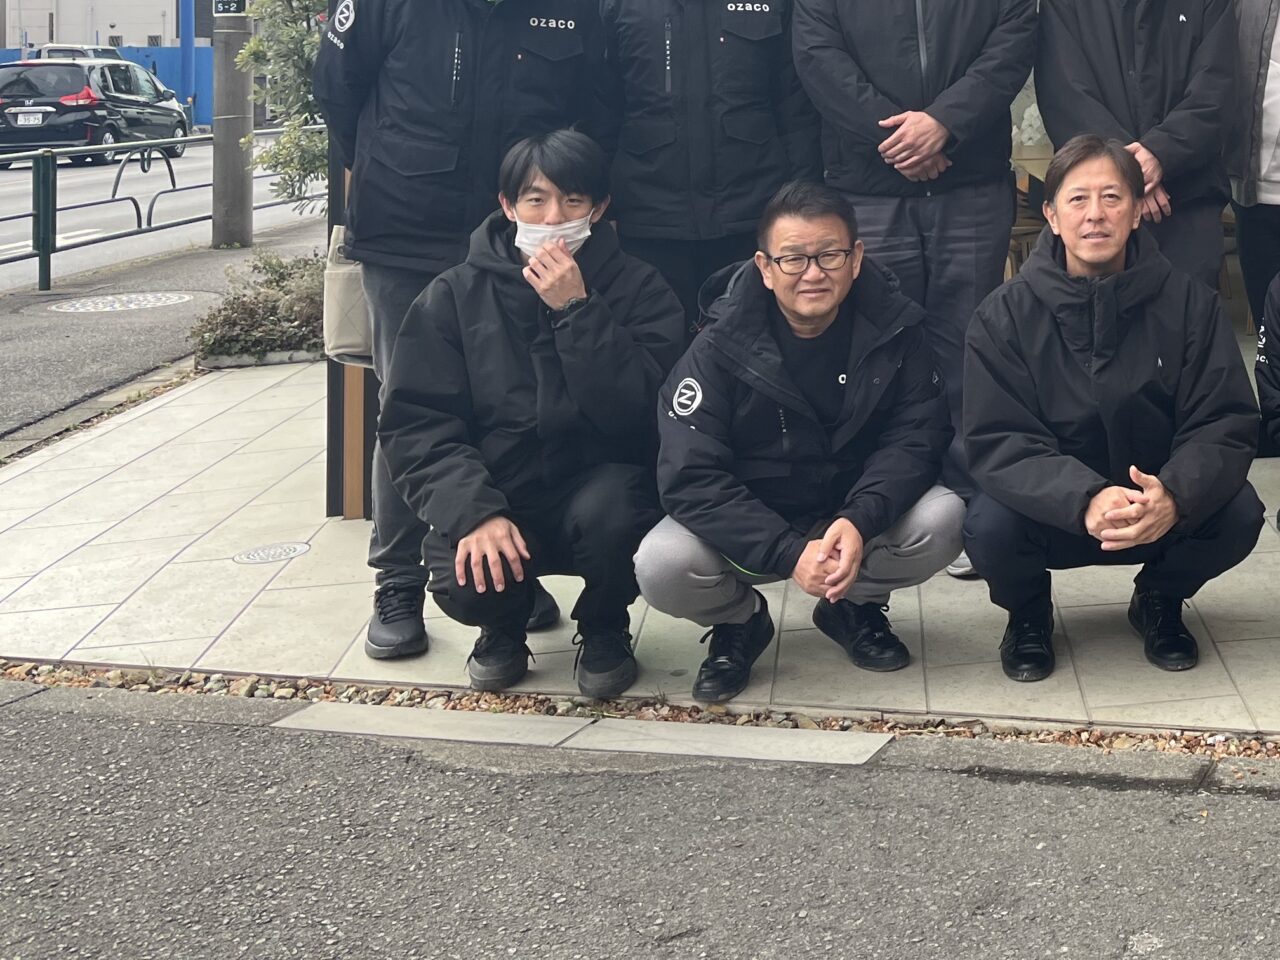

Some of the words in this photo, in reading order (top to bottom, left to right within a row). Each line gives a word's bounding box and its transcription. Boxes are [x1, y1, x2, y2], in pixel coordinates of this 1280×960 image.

[727, 3, 770, 12] ozaco
[529, 17, 575, 29] ozaco
[327, 31, 344, 49] ozaco
